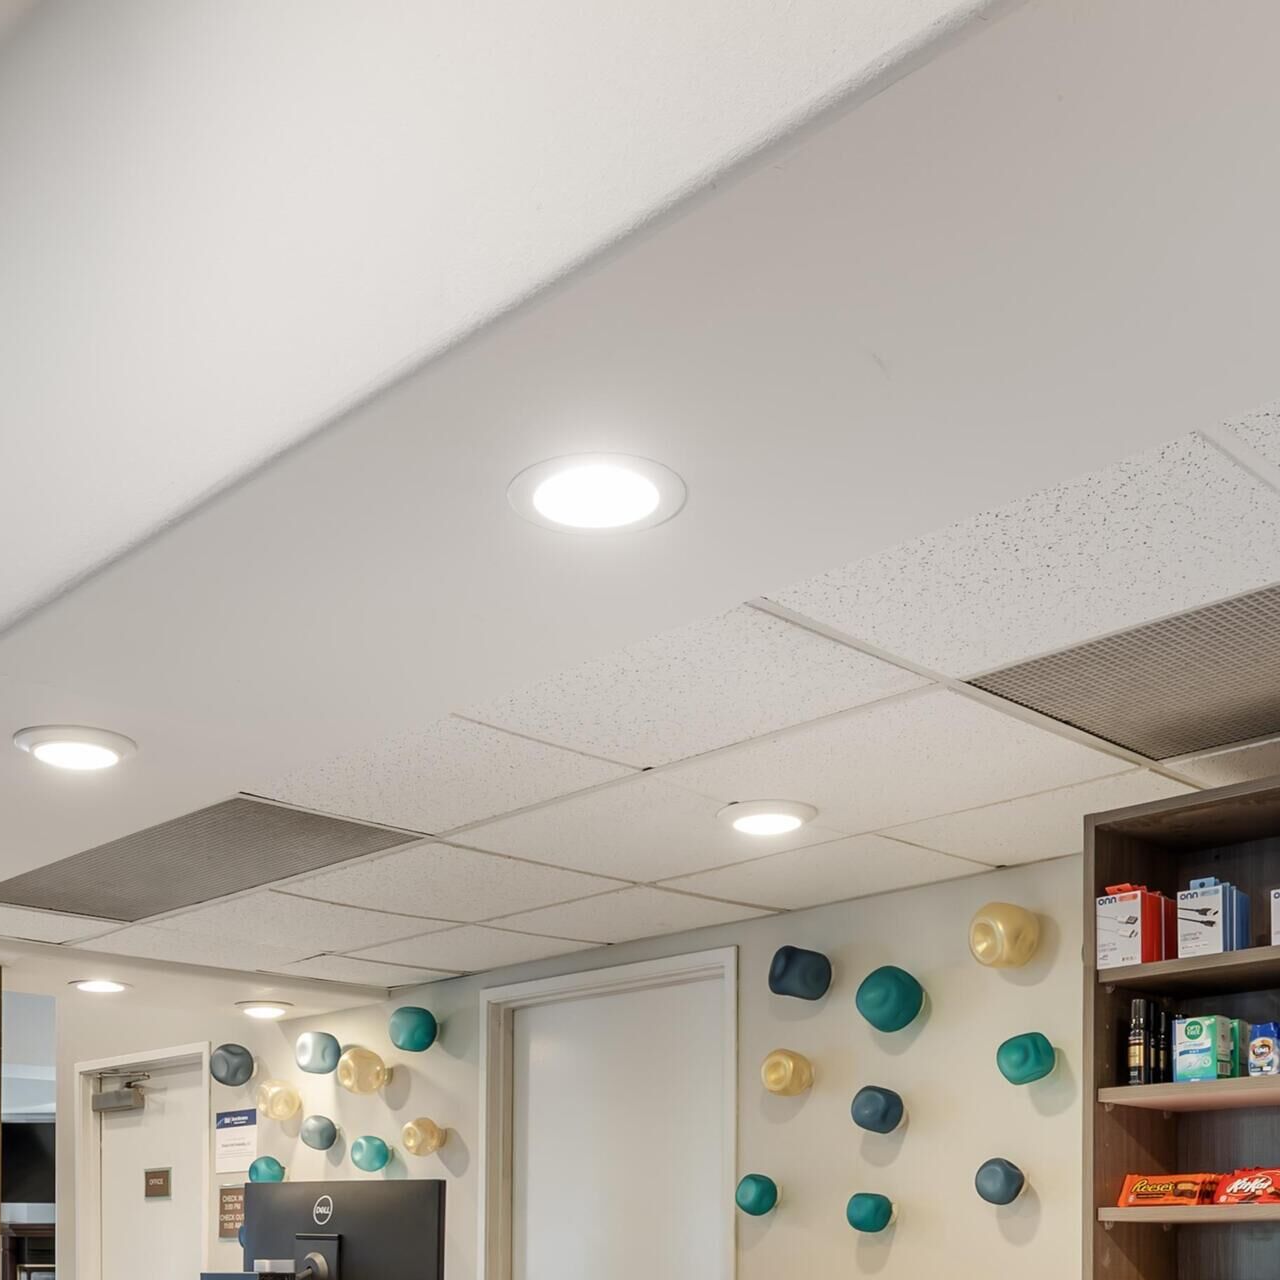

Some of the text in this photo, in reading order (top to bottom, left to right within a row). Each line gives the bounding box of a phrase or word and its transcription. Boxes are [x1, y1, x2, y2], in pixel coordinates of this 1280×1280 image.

[1098, 896, 1116, 906] onn
[1180, 891, 1199, 901] onn
[222, 1195, 236, 1203] CHECK
